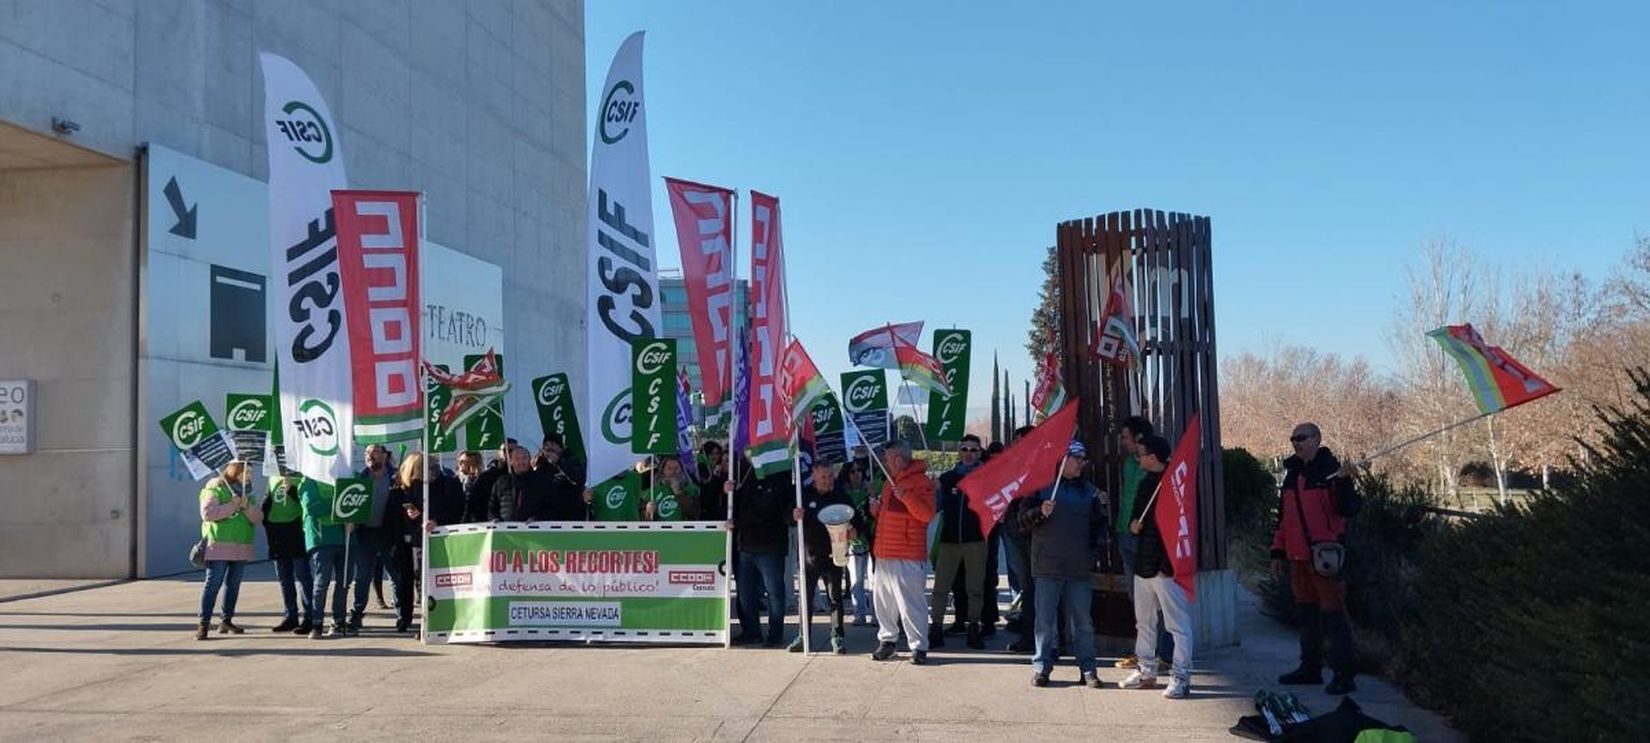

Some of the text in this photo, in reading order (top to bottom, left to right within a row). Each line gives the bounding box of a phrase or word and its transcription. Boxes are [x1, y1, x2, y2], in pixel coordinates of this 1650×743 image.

[597, 188, 655, 342] CSIF
[427, 305, 486, 347] TEATRO
[512, 551, 524, 573] A
[529, 551, 560, 573] LOS
[565, 551, 660, 574] RECORTES!
[559, 580, 576, 592] de
[582, 582, 596, 592] lo
[603, 581, 660, 597] público!
[511, 606, 620, 620] CETURSA SIERRA NEVADA
